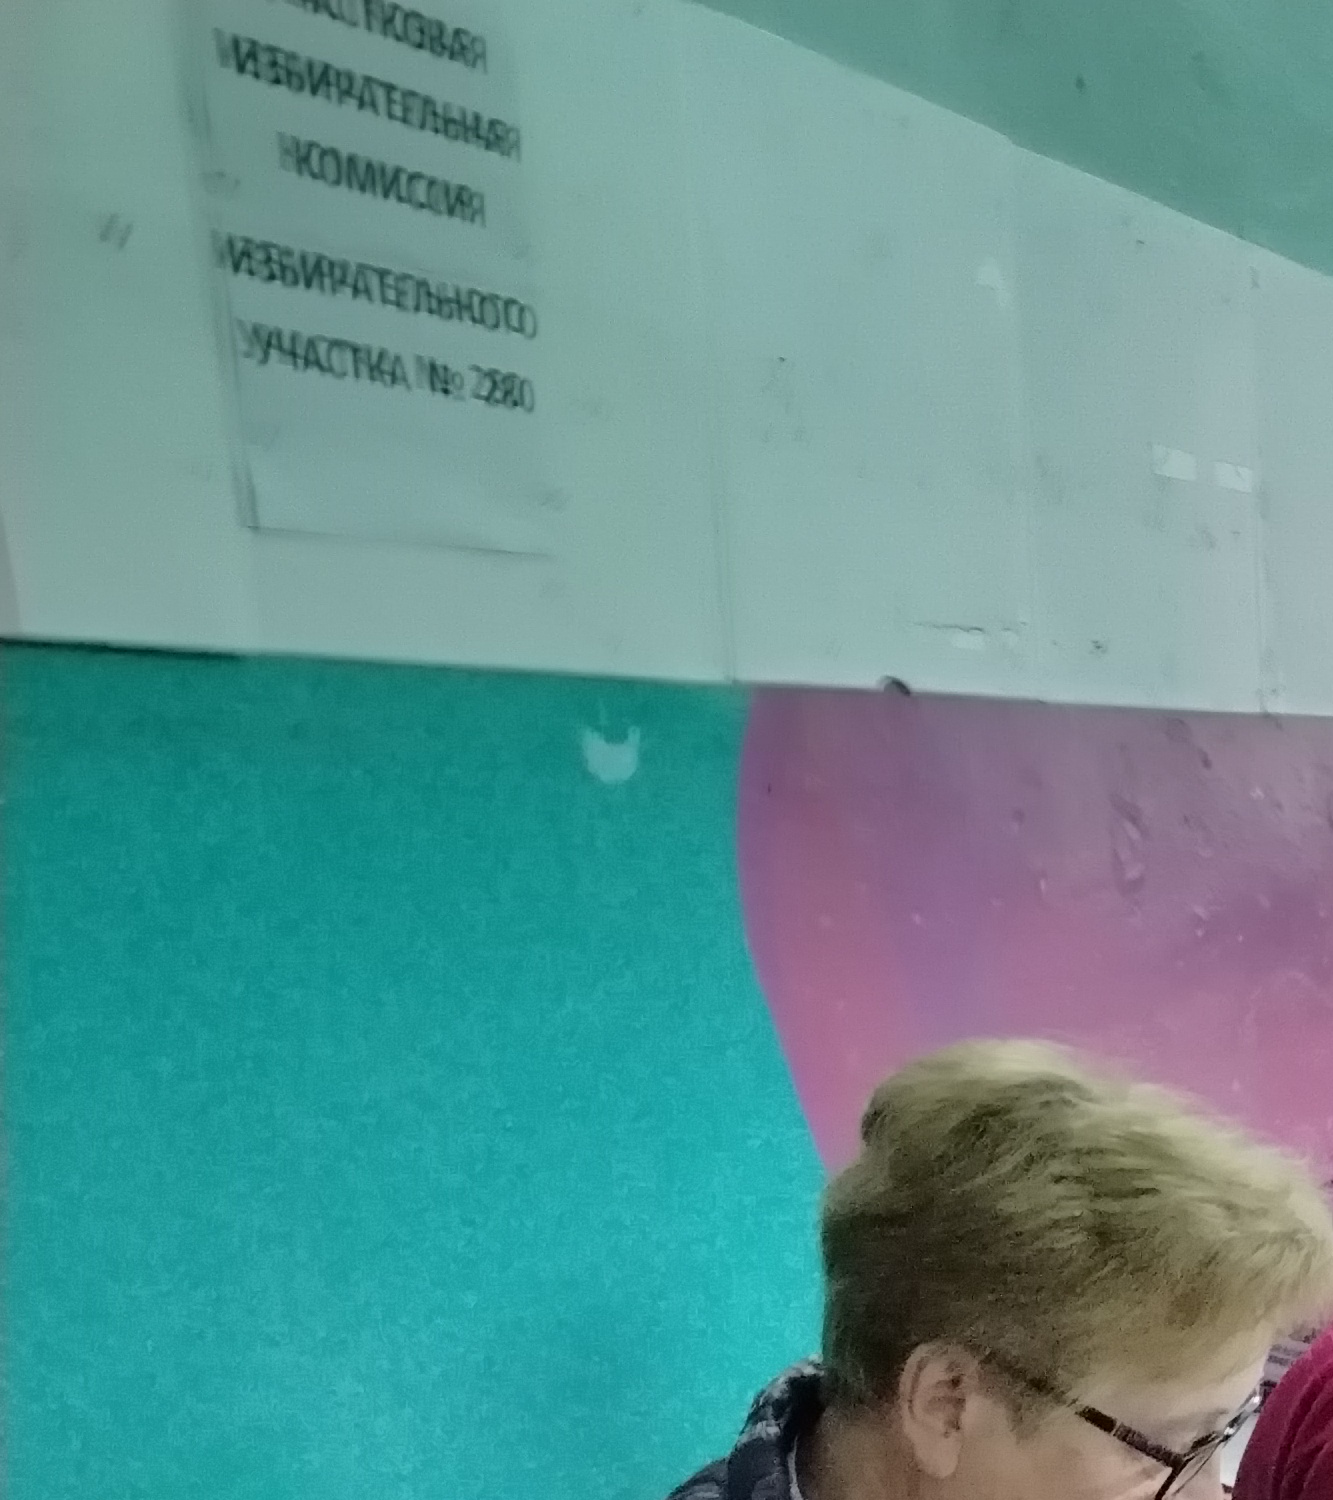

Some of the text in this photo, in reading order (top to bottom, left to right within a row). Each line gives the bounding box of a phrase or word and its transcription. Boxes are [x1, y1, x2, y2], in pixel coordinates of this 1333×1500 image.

[213, 27, 521, 163] ИЗБИРАТЕЛЬНАЯ
[277, 131, 487, 228] КОМИССИЯ
[210, 229, 538, 340] ИЗБИРАТЕЛЬНОГО
[236, 317, 412, 392] УЧАСТКА
